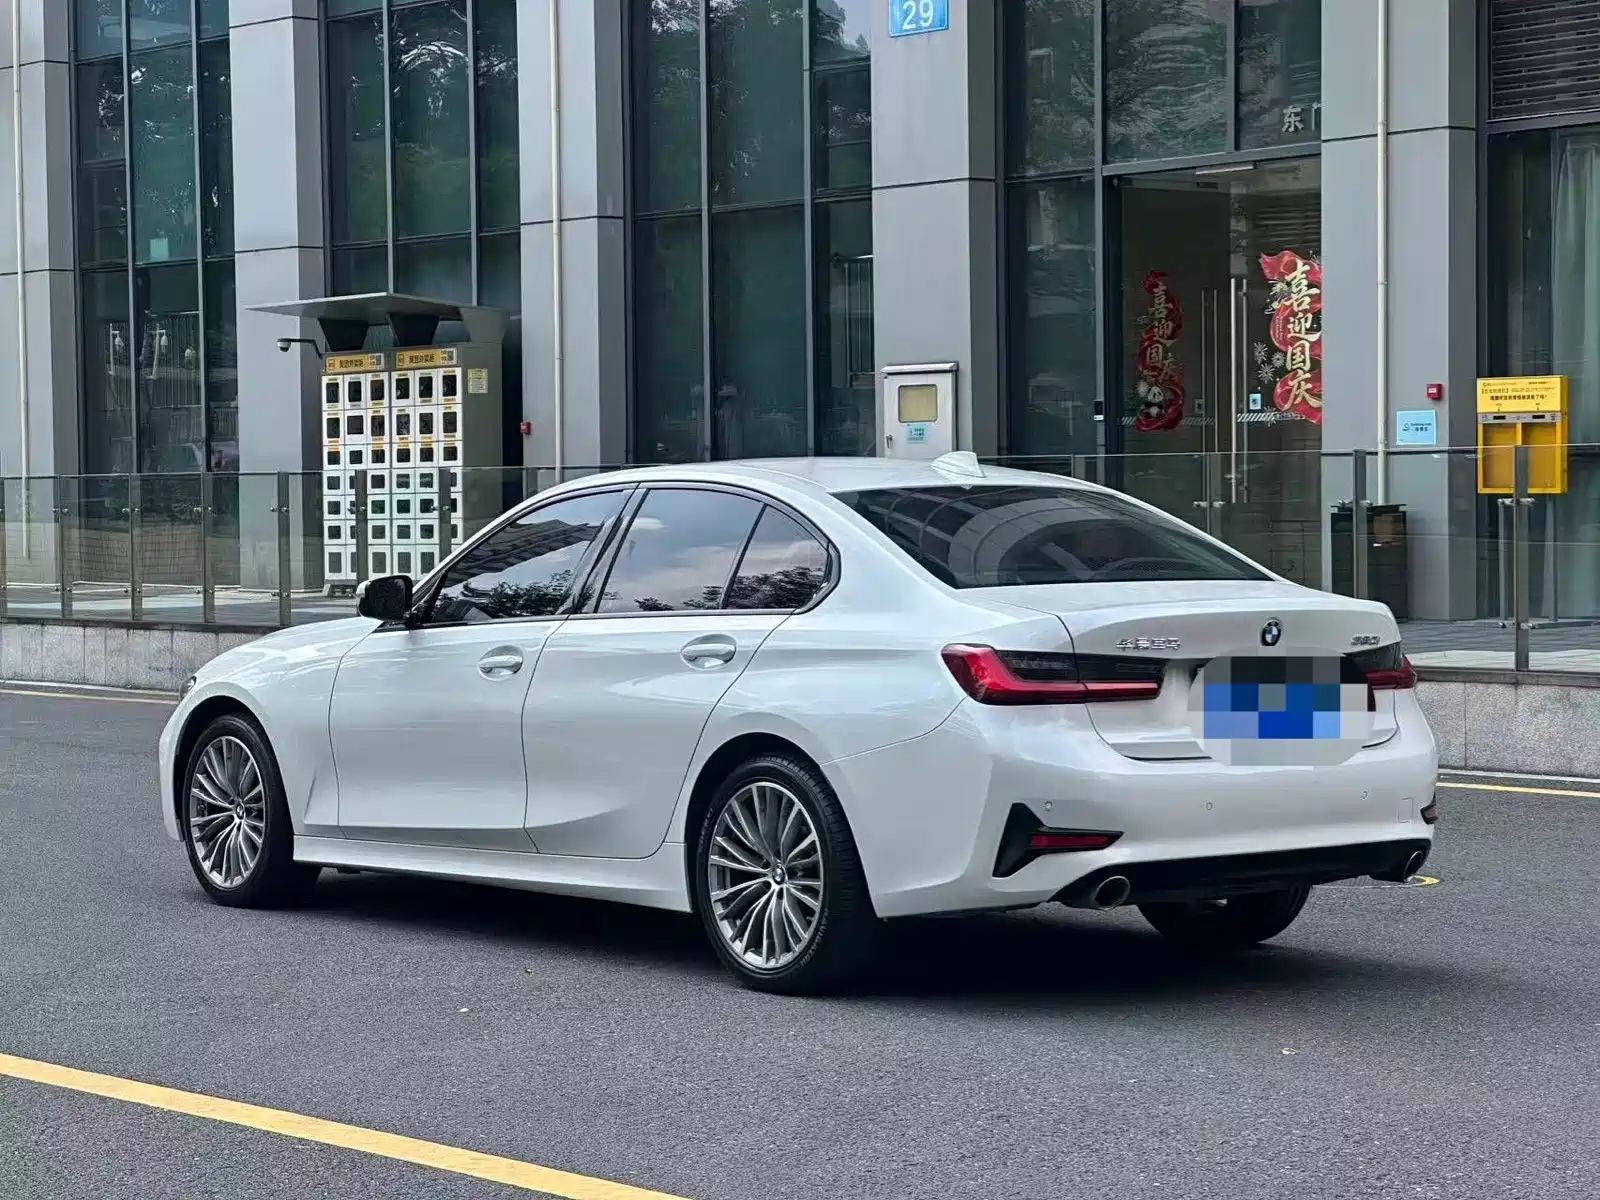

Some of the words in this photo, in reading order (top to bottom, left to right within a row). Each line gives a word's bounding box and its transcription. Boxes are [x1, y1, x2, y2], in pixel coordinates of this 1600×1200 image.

[902, 0, 934, 30] 29
[1284, 258, 1322, 411] 喜迎国庆
